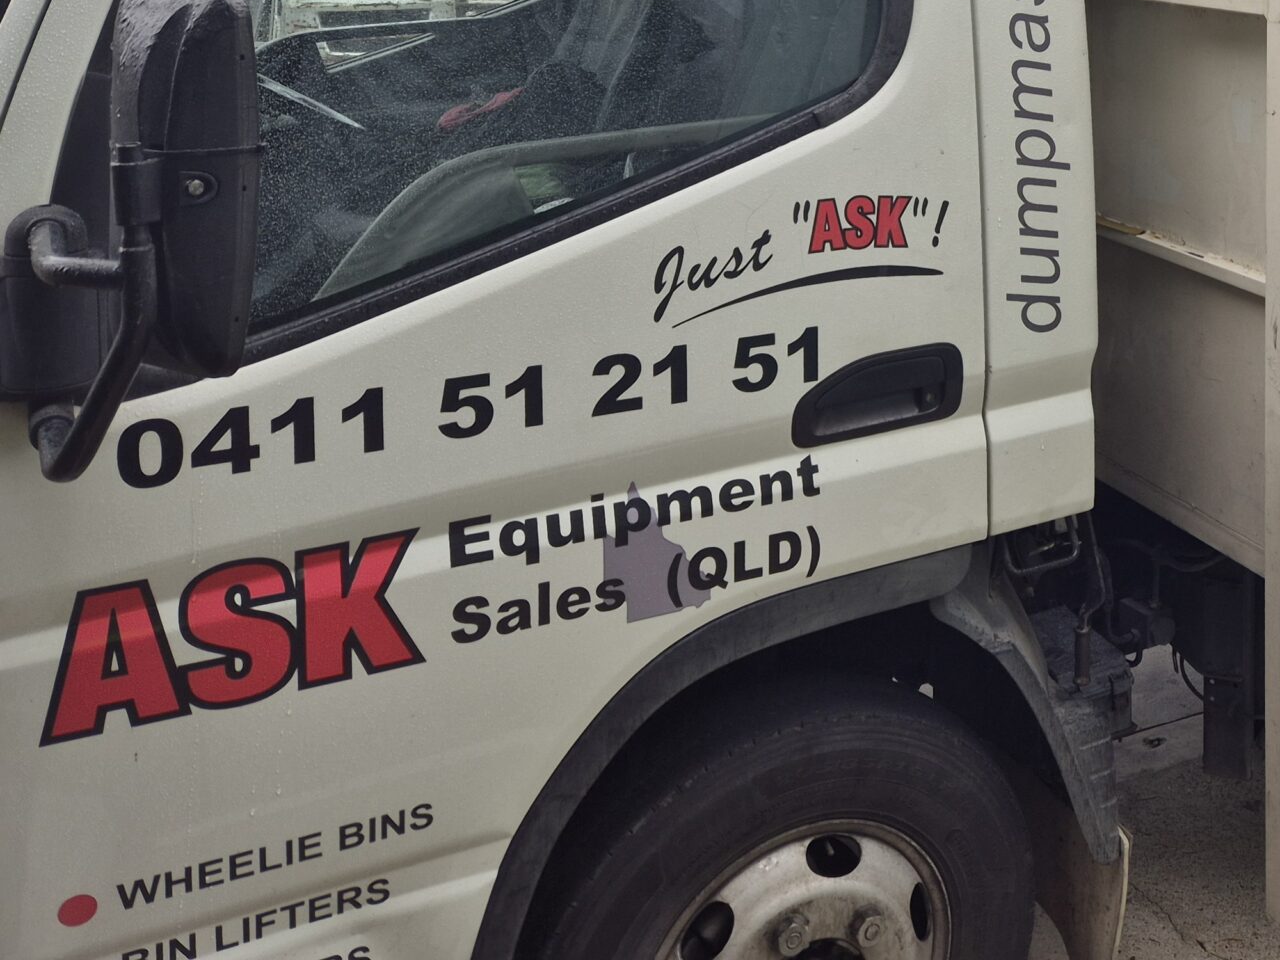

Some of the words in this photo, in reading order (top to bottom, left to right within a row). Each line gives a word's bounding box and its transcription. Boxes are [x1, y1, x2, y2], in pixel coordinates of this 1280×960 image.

[653, 229, 773, 323] Just
[116, 387, 386, 489] 0411
[437, 364, 544, 439] 51
[591, 344, 689, 418] 21
[731, 326, 821, 393] 51
[448, 454, 821, 568] Equipment
[39, 527, 427, 748] ASK
[451, 578, 626, 644] Sales
[667, 525, 821, 608] (QLD)
[116, 831, 324, 911] WHEELIE
[339, 803, 435, 852] BINS
[215, 878, 391, 952] LIFTERS
